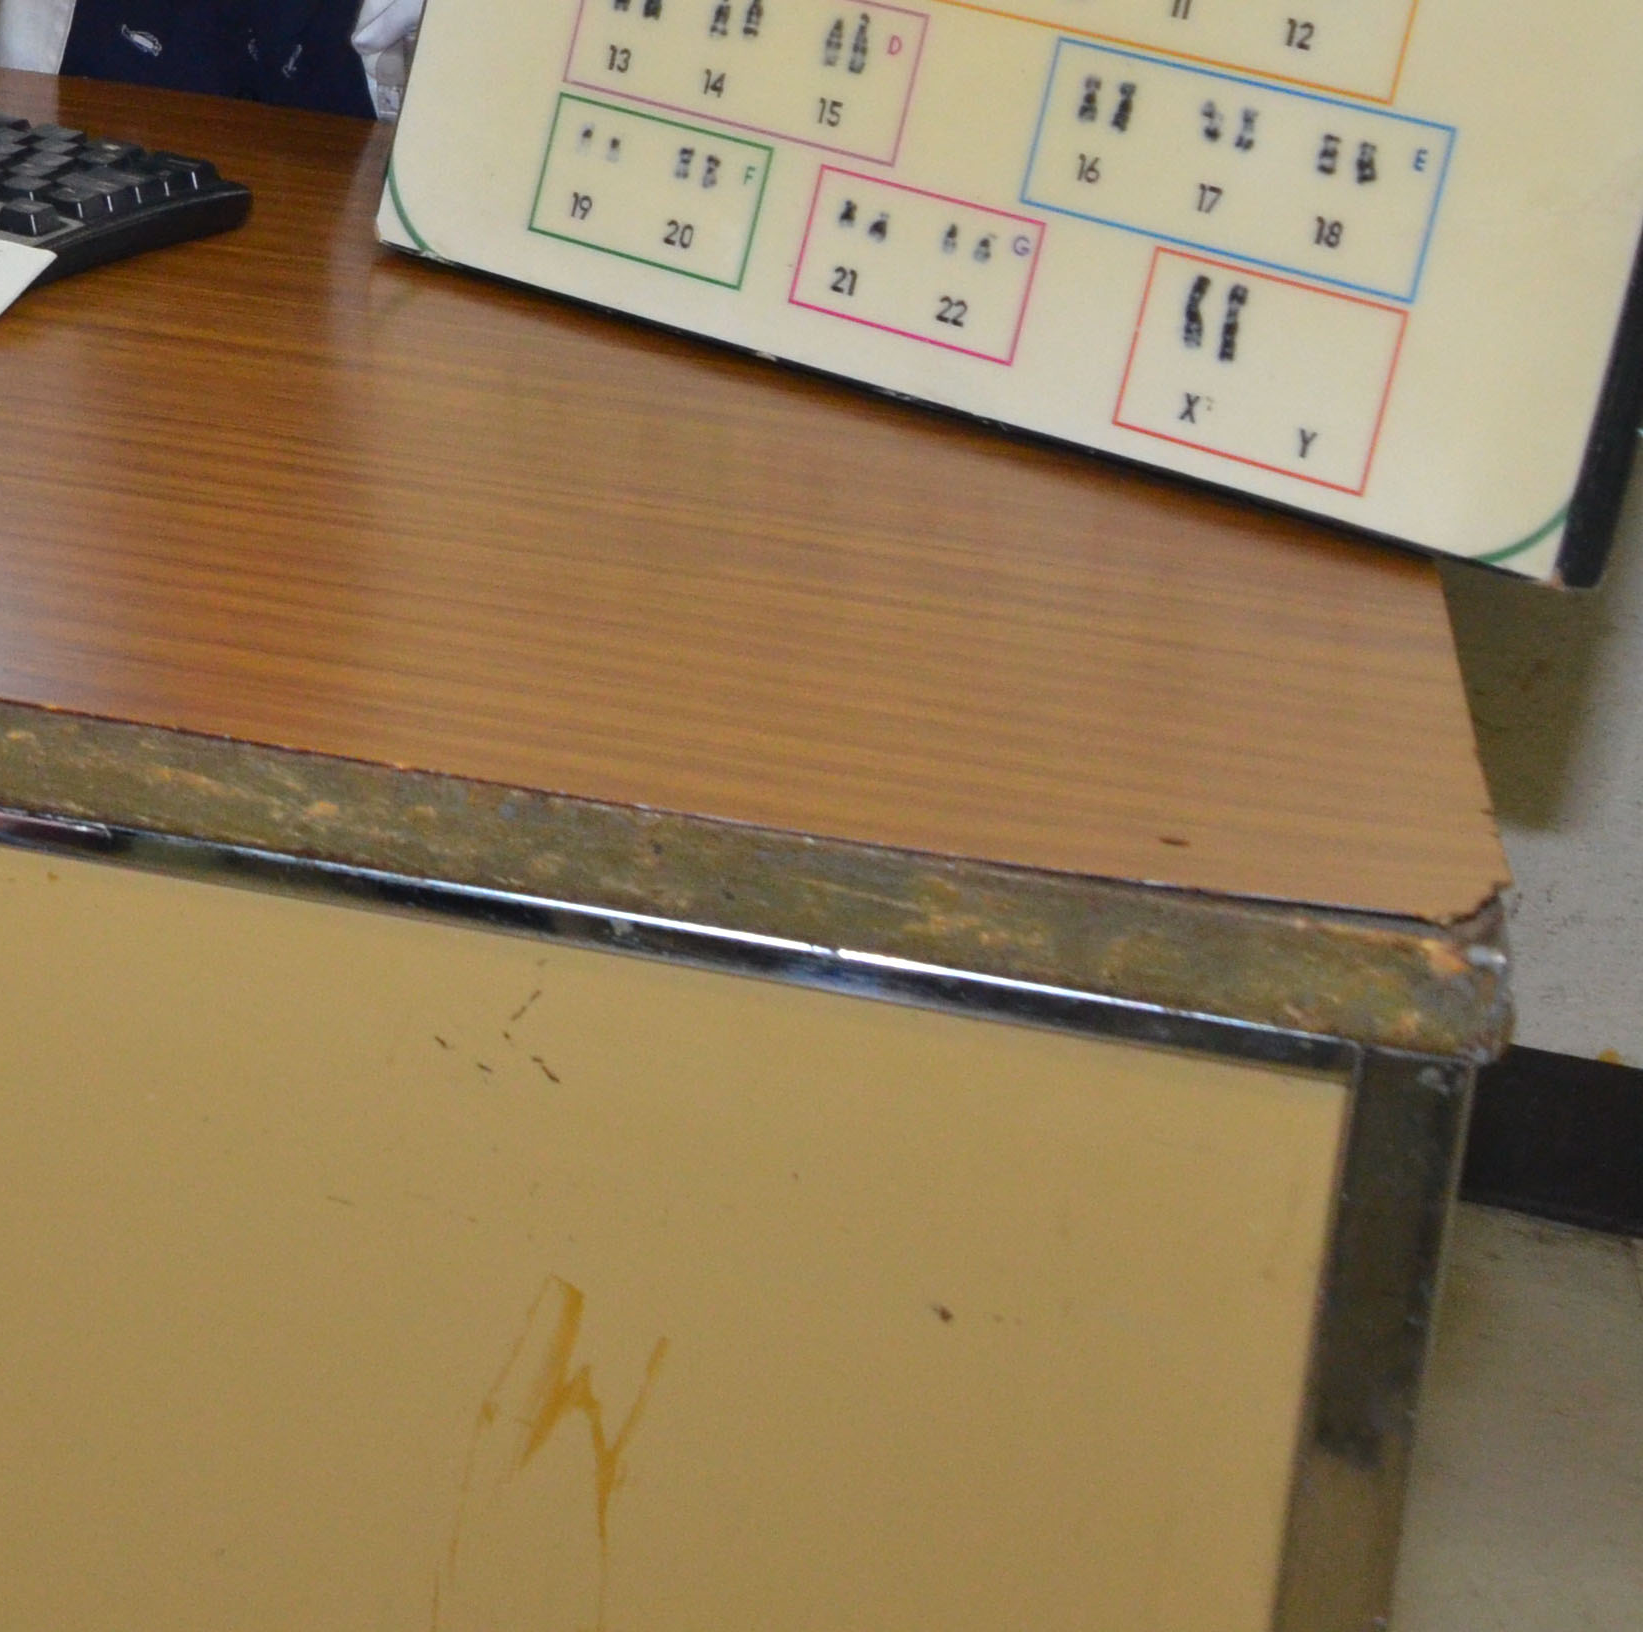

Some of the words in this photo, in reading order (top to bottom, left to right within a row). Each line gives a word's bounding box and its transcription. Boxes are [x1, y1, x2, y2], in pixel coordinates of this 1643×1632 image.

[886, 34, 903, 57] D
[1285, 17, 1315, 51] 12
[607, 44, 632, 74] 13
[703, 68, 726, 98] 14
[817, 97, 844, 128] 15
[743, 165, 756, 185] F
[1412, 148, 1428, 172] E
[570, 191, 593, 221] 19
[662, 219, 694, 250] 20
[1076, 153, 1101, 185] 16
[1197, 183, 1223, 214] 17
[1314, 215, 1344, 249] 18
[1013, 236, 1030, 256] G
[829, 265, 858, 297] 21
[935, 295, 968, 328] 22
[1178, 392, 1201, 424] X
[1298, 428, 1318, 459] Y
